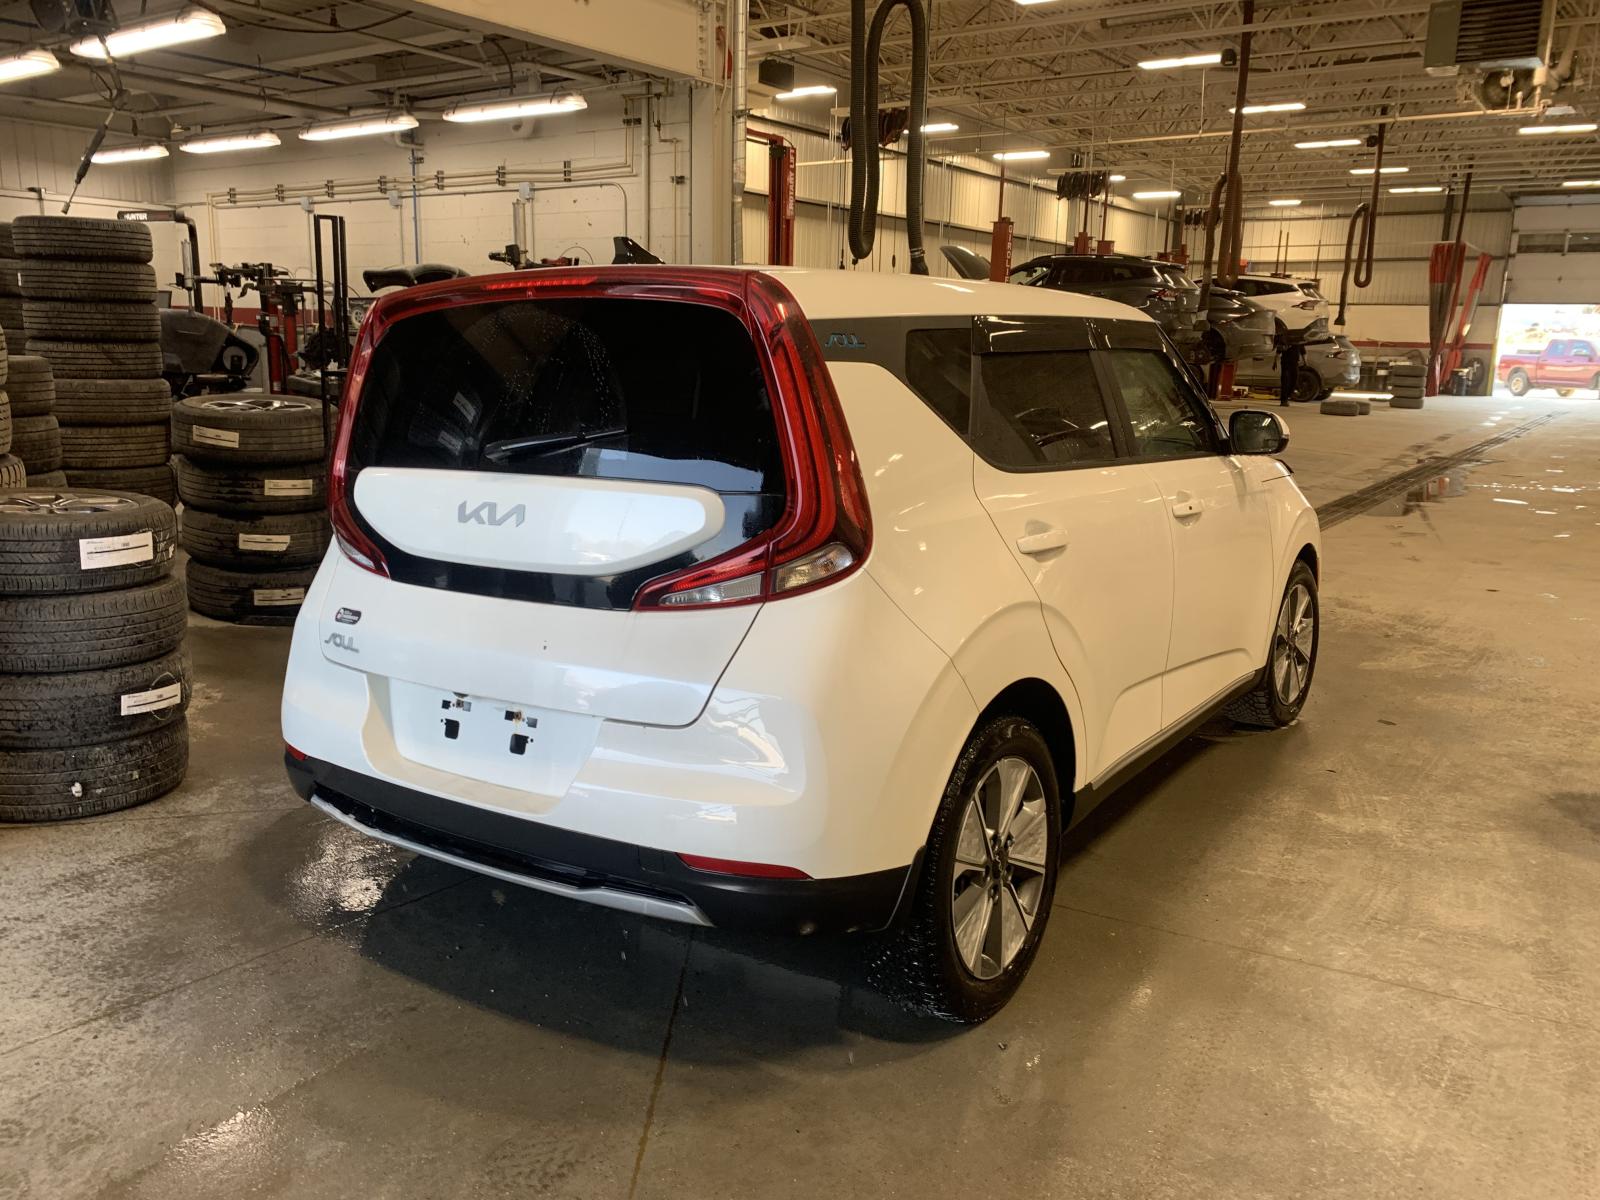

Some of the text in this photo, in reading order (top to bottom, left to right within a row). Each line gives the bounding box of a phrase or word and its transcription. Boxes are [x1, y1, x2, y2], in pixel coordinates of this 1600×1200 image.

[824, 334, 866, 348] SOUL
[457, 500, 526, 527] KIA
[324, 633, 360, 653] SOUL
